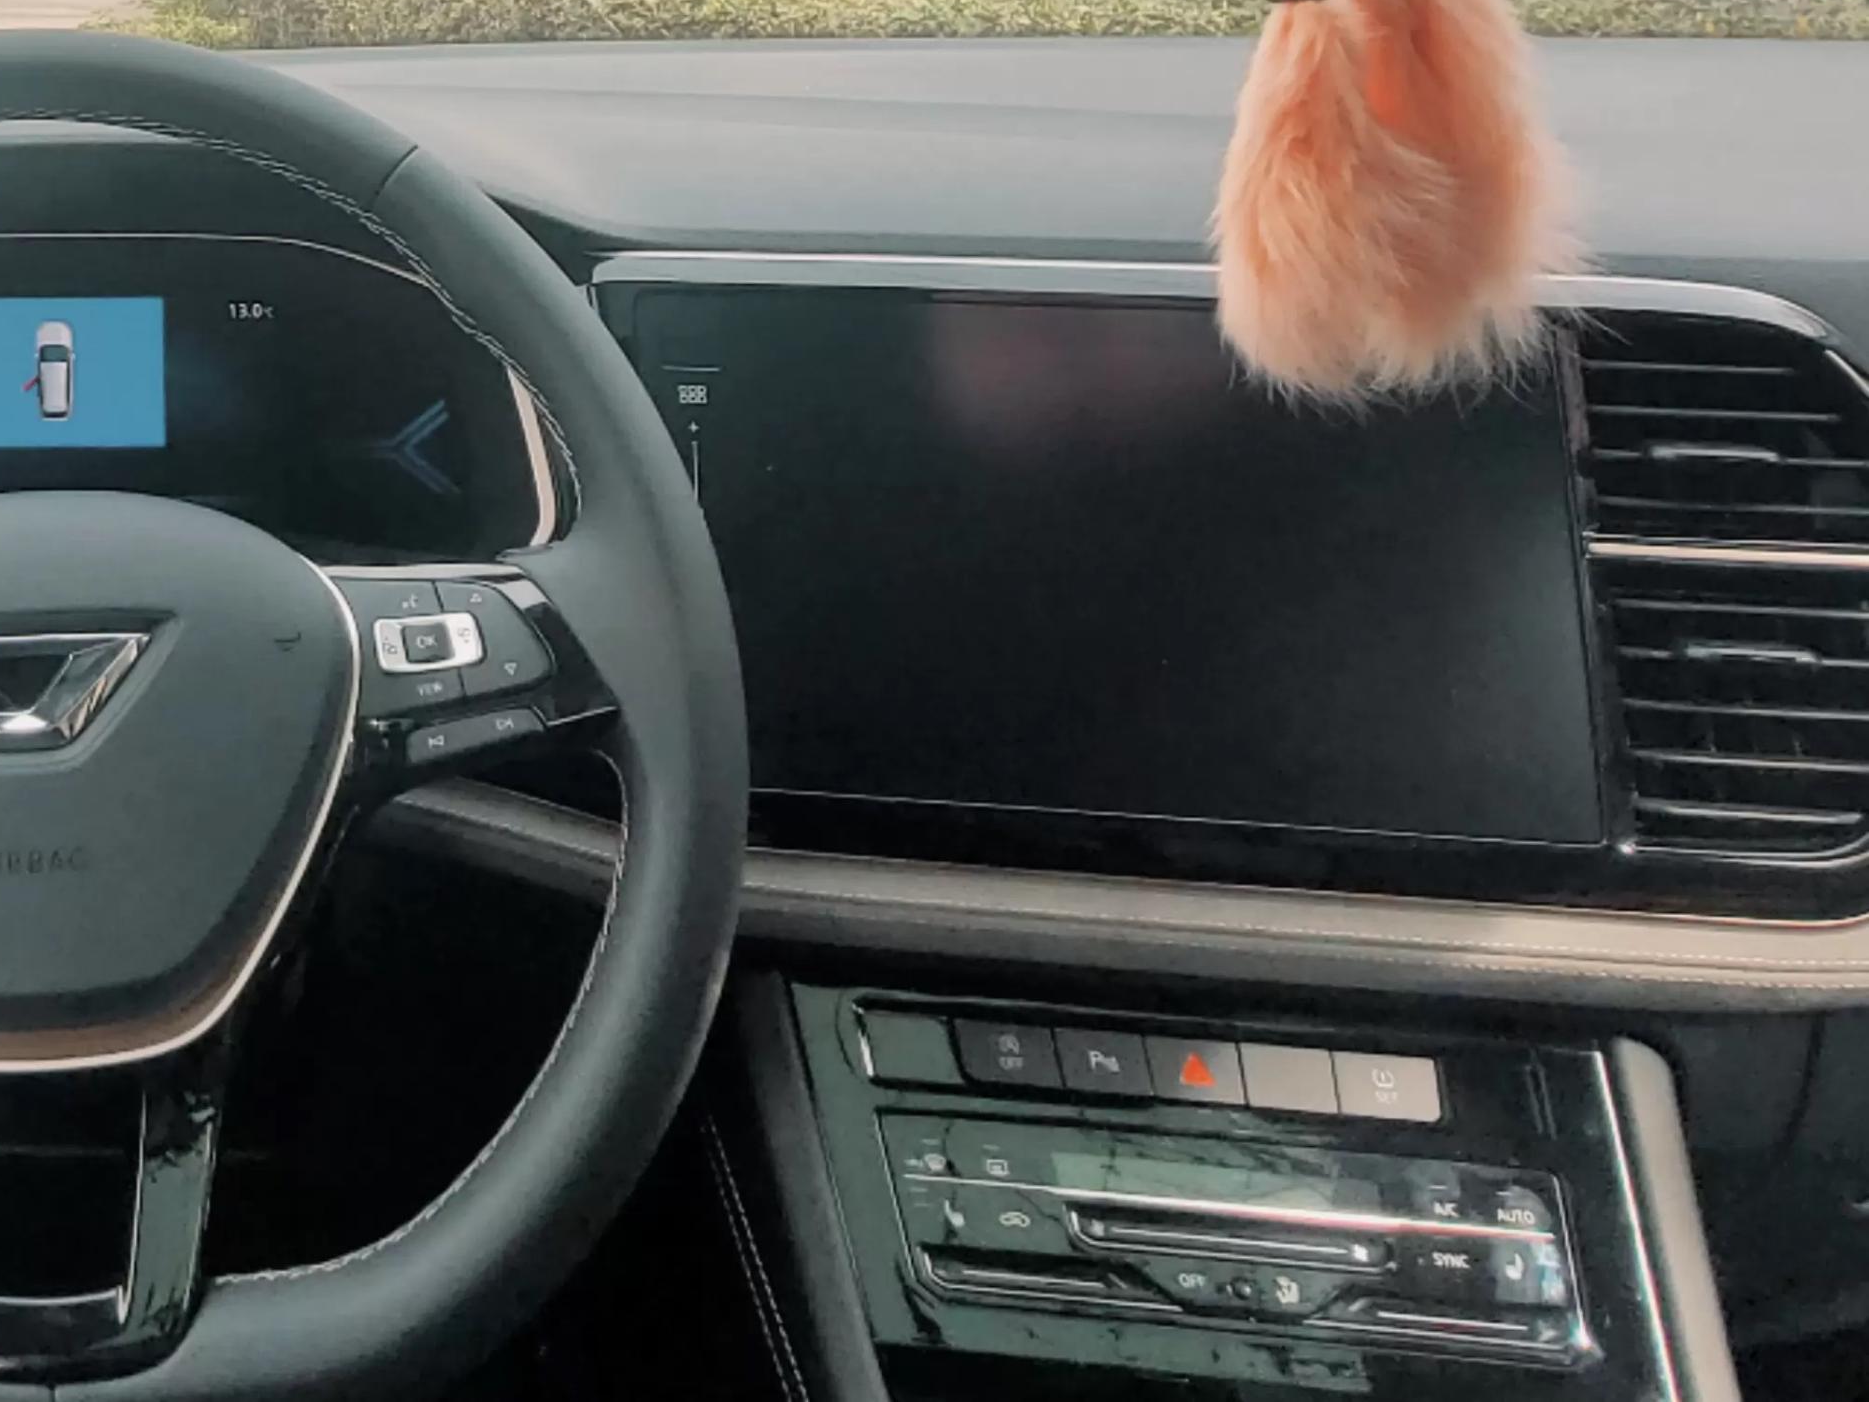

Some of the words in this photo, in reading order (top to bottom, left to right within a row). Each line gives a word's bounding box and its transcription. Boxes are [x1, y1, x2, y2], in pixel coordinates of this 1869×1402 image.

[416, 634, 438, 649] OK
[1497, 1208, 1535, 1225] AUTO
[1432, 1252, 1471, 1269] SYNC
[1178, 1272, 1207, 1288] OFF
